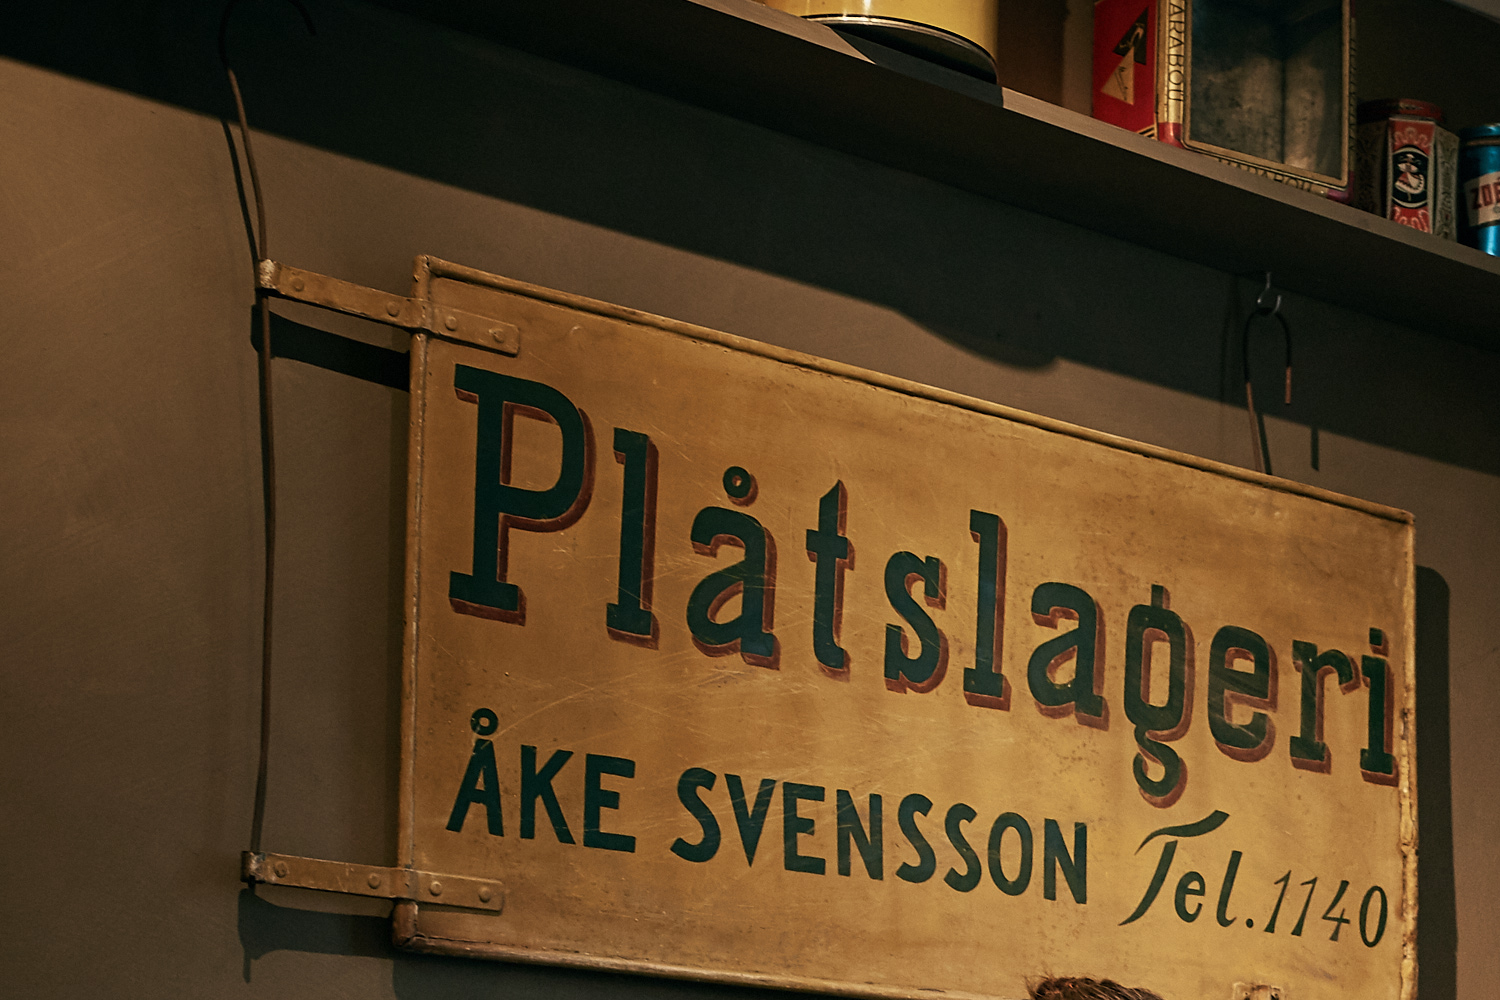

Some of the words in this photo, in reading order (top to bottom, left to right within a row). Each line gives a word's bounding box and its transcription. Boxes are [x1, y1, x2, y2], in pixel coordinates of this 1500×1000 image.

[448, 362, 1400, 808] Plåtslageri
[445, 707, 636, 853] ÅKE
[669, 766, 1088, 905] SVENSSON
